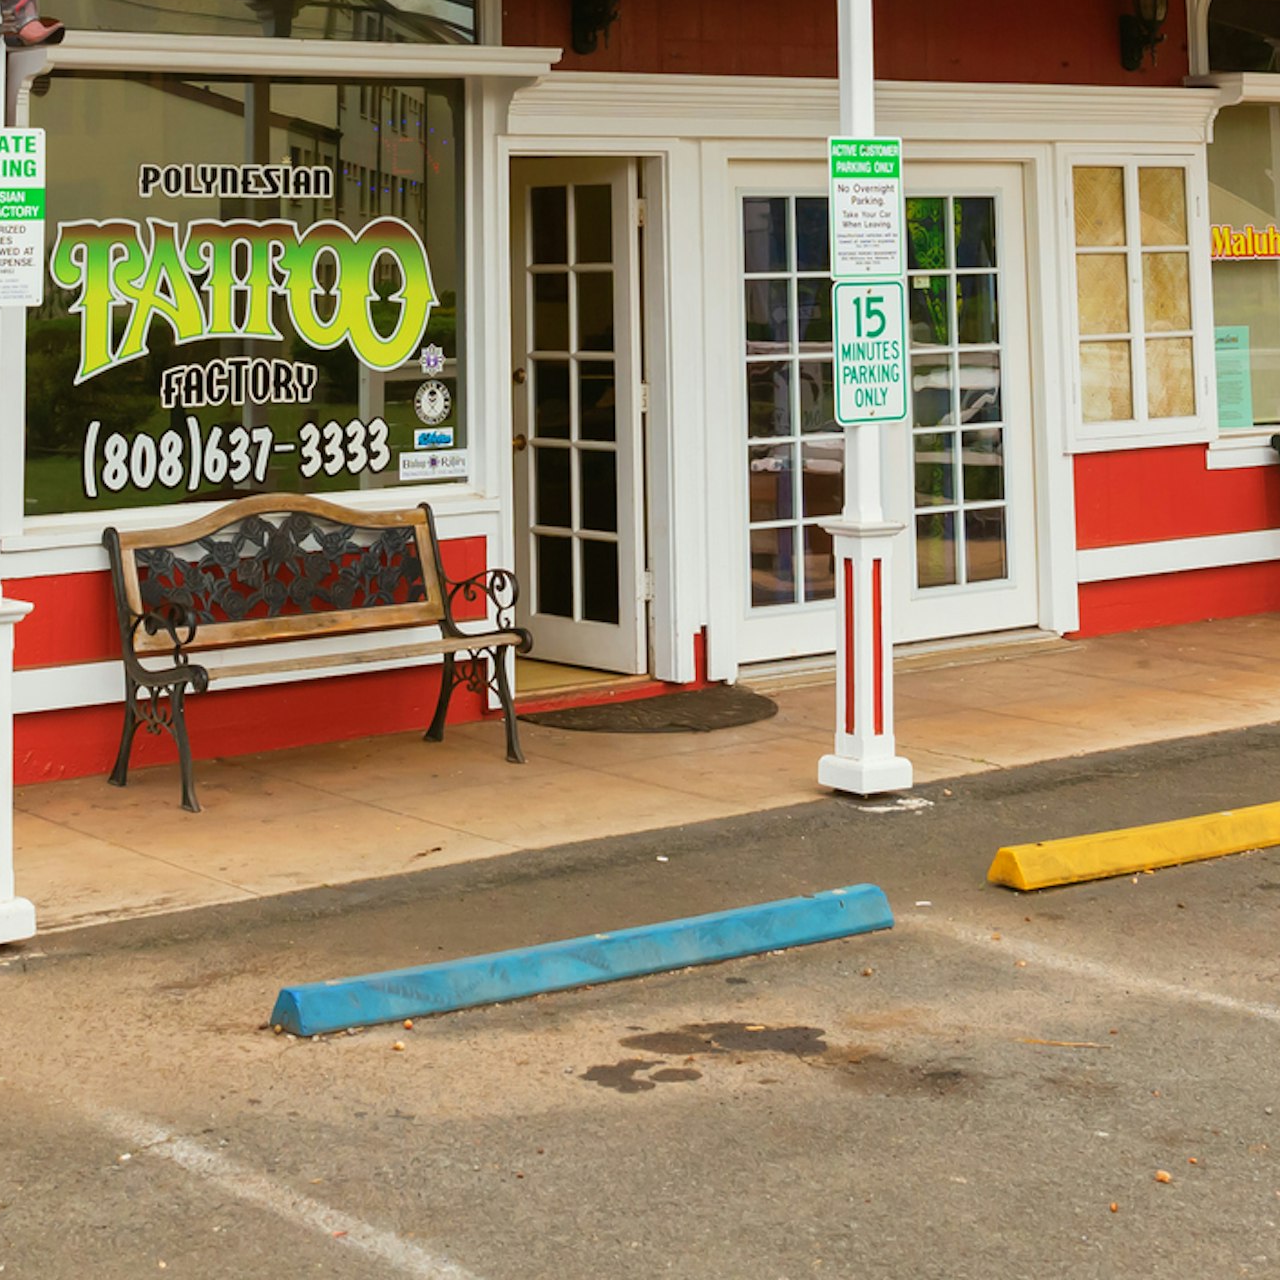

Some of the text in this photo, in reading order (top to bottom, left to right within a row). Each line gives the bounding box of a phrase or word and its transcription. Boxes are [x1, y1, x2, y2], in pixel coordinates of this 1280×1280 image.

[832, 144, 898, 156] ACTIVE CUSTOMER
[836, 161, 895, 173] PARKING ONLY
[139, 163, 333, 199] POLYNESIAN
[837, 183, 895, 195] No Overnight
[841, 220, 862, 228] When
[842, 210, 892, 218] Take Your Car
[23, 247, 35, 256] AT
[50, 215, 440, 386] TATTOO
[852, 296, 886, 338] 15
[841, 340, 900, 363] MINUTES
[161, 356, 319, 409] FACTORY
[842, 363, 900, 385] PARKING
[854, 386, 888, 408] ONLY
